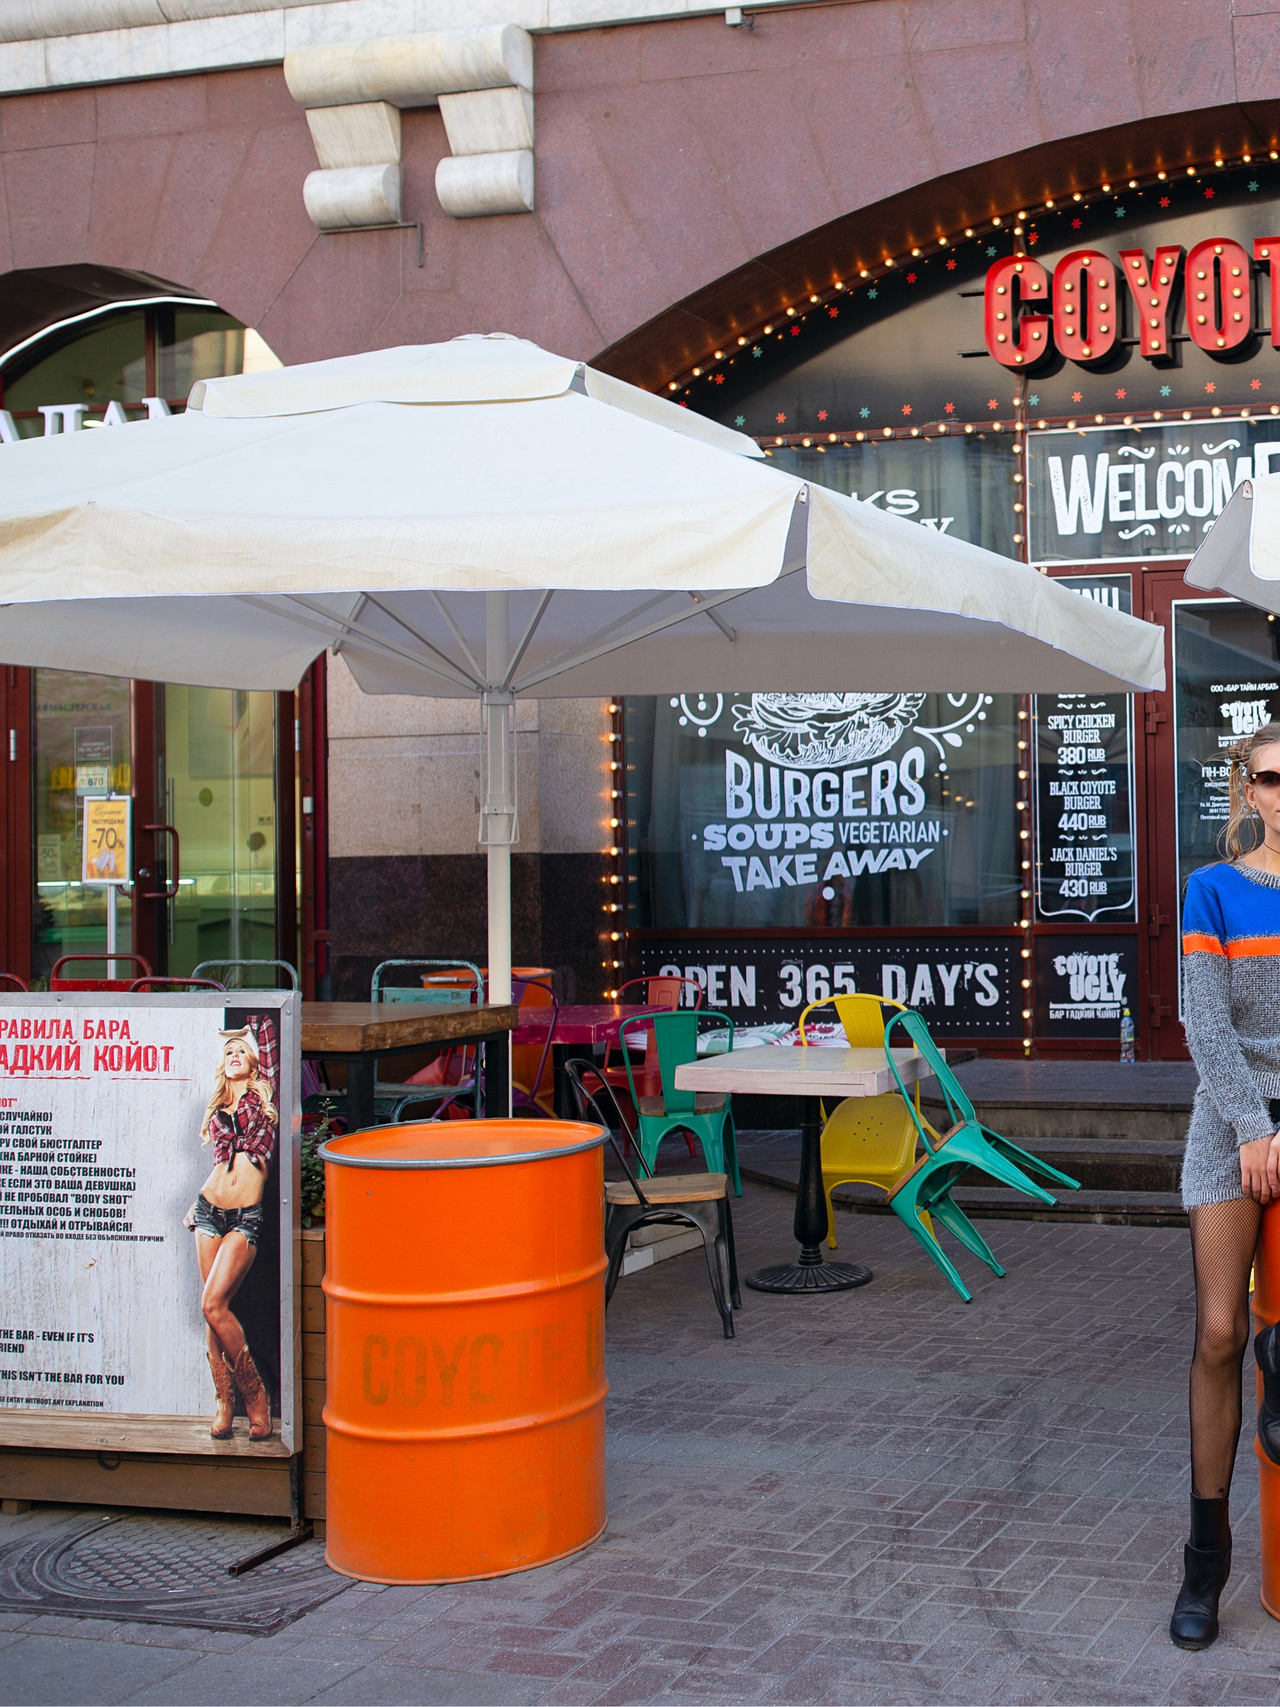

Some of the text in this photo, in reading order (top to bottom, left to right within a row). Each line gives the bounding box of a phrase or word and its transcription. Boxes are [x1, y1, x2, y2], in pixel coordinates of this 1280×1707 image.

[1210, 684, 1224, 692] ООО
[1240, 682, 1256, 691] ТАЙМ
[1219, 700, 1268, 717] COYOTE
[1048, 713, 1116, 729] SPICY CHICKEN
[1063, 729, 1101, 744] BURGER
[1058, 746, 1106, 765] 380 RUB
[726, 746, 925, 819] BURGERS
[1049, 780, 1116, 796] BLACK COYOTE
[1064, 795, 1102, 810] BURGER
[1058, 812, 1107, 831] 440 RUB
[91, 827, 125, 849] -70%
[703, 820, 940, 851] SOUPS VEGETARIAN
[1050, 847, 1118, 862] JACK DANIEL'S
[721, 847, 935, 893] TAKE AWAY
[1064, 861, 1103, 877] BURGER
[1059, 879, 1108, 898] 430 RUB
[1051, 953, 1121, 976] COYOTE
[779, 963, 856, 1008] 365
[882, 963, 1000, 1007] DAY'S
[1069, 973, 1127, 1002] UGLY
[1050, 1006, 1121, 1020] БАР ГАДКИЙ КОЙОТ
[83, 1020, 131, 1040] БАРА
[93, 1041, 174, 1072] КОЙОТ
[12, 1125, 52, 1135] ГАЛСТУК
[12, 1137, 38, 1148] СВОЙ
[40, 1139, 102, 1150] БЮСТГАЛТЕР
[18, 1151, 54, 1162] БАРНОЙ
[57, 1152, 97, 1164] СТОЙКЕ)
[20, 1165, 48, 1176] НАША
[50, 1166, 136, 1178] СОБСТВЕННОСТЬ!
[8, 1178, 32, 1189] ЕСЛИ
[34, 1179, 52, 1190] ЭТО
[54, 1180, 83, 1190] ВАША
[84, 1180, 136, 1192] ДЕВУШКА)
[4, 1192, 16, 1202] НЕ
[18, 1192, 69, 1203] ПРОБОВАЛ
[71, 1193, 100, 1204] "BODY
[102, 1194, 133, 1205] SHOT"
[46, 1206, 72, 1217] ОСОБ
[74, 1208, 81, 1217] И
[82, 1208, 126, 1218] СНОБОВ!
[10, 1218, 58, 1230] ОТДЫХАЙ
[60, 1220, 66, 1230] И
[68, 1219, 133, 1232] ОТРЫВАЙСЯ!
[25, 1232, 55, 1240] ОТКАЗАТЬ
[98, 1234, 138, 1242] ОБЪЯСНЕНИЯ
[16, 1330, 34, 1340] BAR
[42, 1331, 65, 1342] EVEN
[66, 1332, 76, 1342] IF
[77, 1333, 94, 1343] IT'S
[19, 1371, 43, 1382] ISN'T
[44, 1372, 62, 1382] THE
[64, 1373, 83, 1384] BAR
[85, 1374, 103, 1384] FOR
[105, 1375, 125, 1386] YOU
[6, 1396, 24, 1404] ENTRY
[25, 1397, 52, 1405] WITHOUT
[52, 1398, 65, 1406] ANY
[65, 1399, 104, 1408] EXPLANATION
